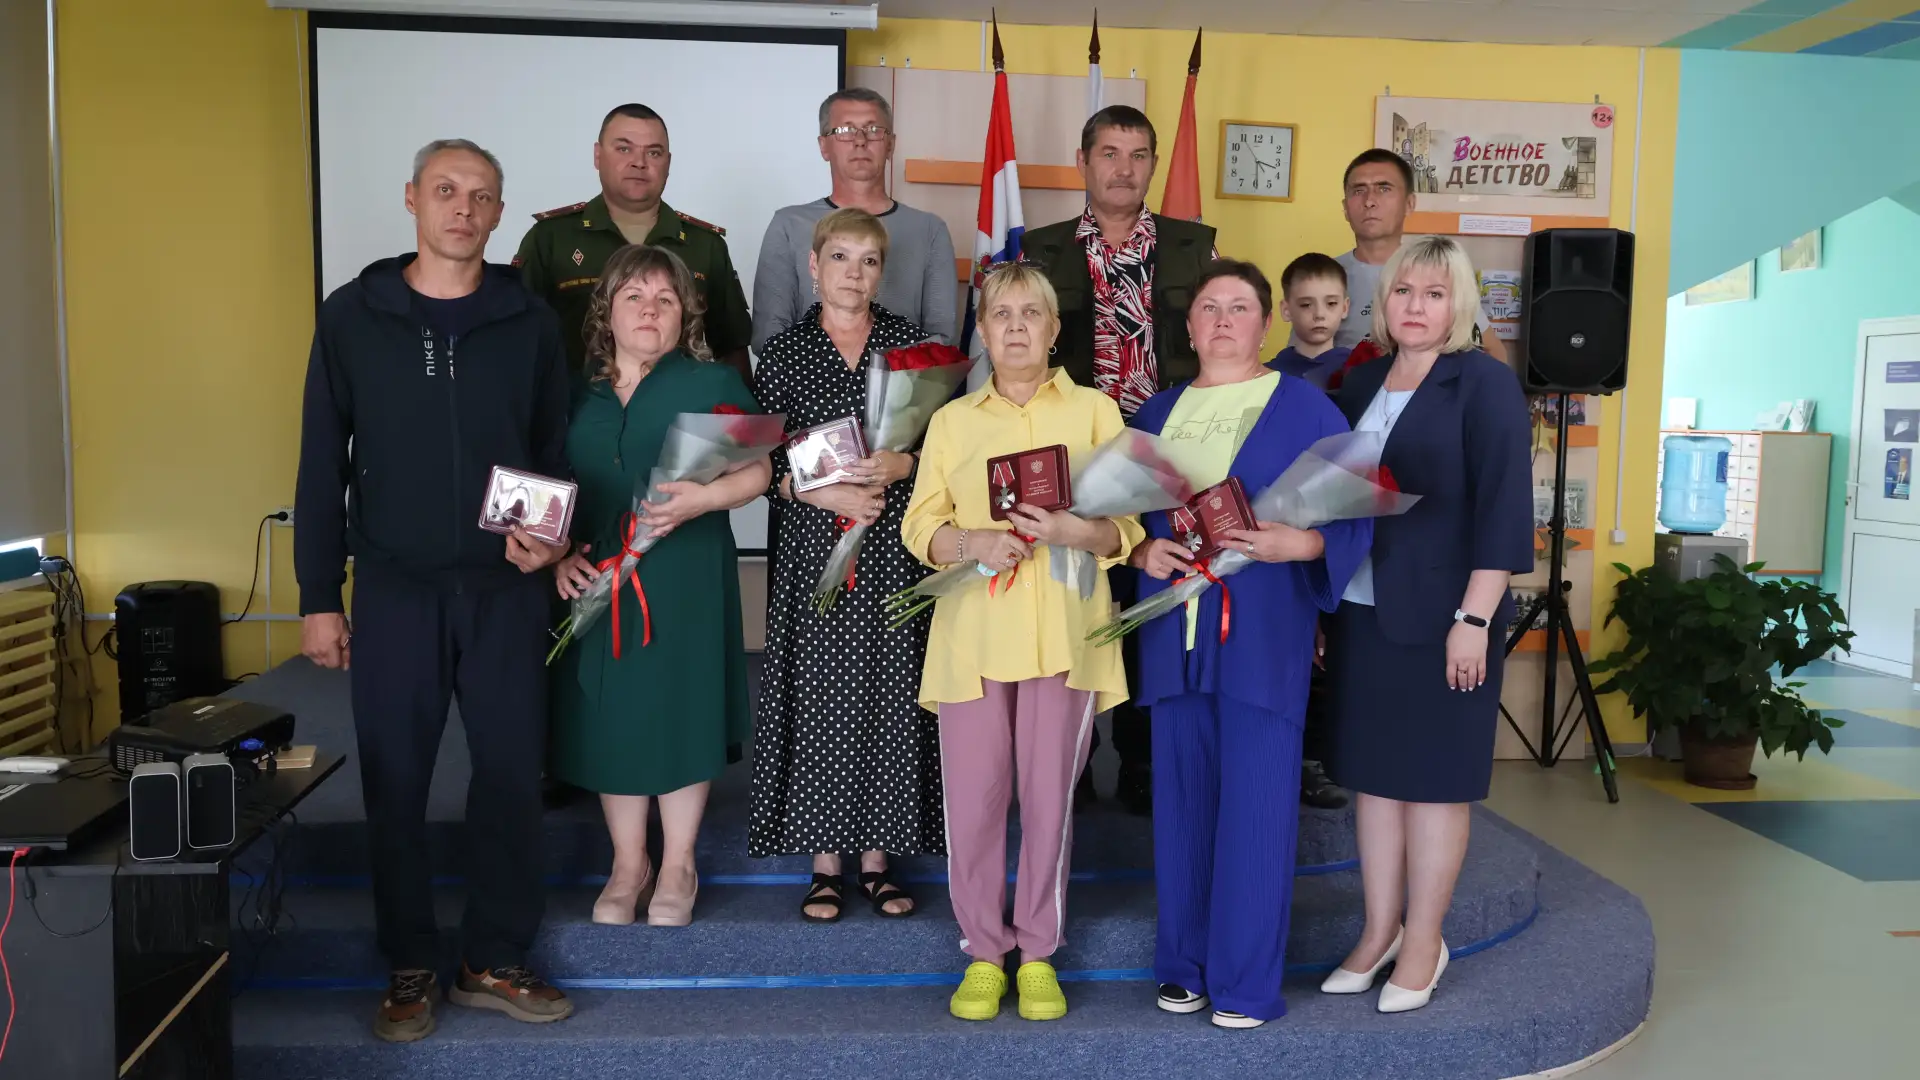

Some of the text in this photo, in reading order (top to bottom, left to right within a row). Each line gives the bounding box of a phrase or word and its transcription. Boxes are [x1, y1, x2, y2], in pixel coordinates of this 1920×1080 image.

[1592, 112, 1612, 122] 12+
[1240, 134, 1247, 142] 11
[1254, 134, 1263, 143] 12
[1270, 135, 1273, 144] 1
[1232, 143, 1240, 151] 10
[1276, 145, 1281, 154] 2
[1232, 155, 1237, 164] 9
[1276, 158, 1280, 167] 3
[1231, 169, 1237, 177] 8
[1446, 163, 1550, 188] ДЕТСТВО
[1239, 178, 1244, 187] 7
[1253, 180, 1258, 189] 6
[1266, 180, 1272, 188] 5
[424, 340, 436, 375] NIKE
